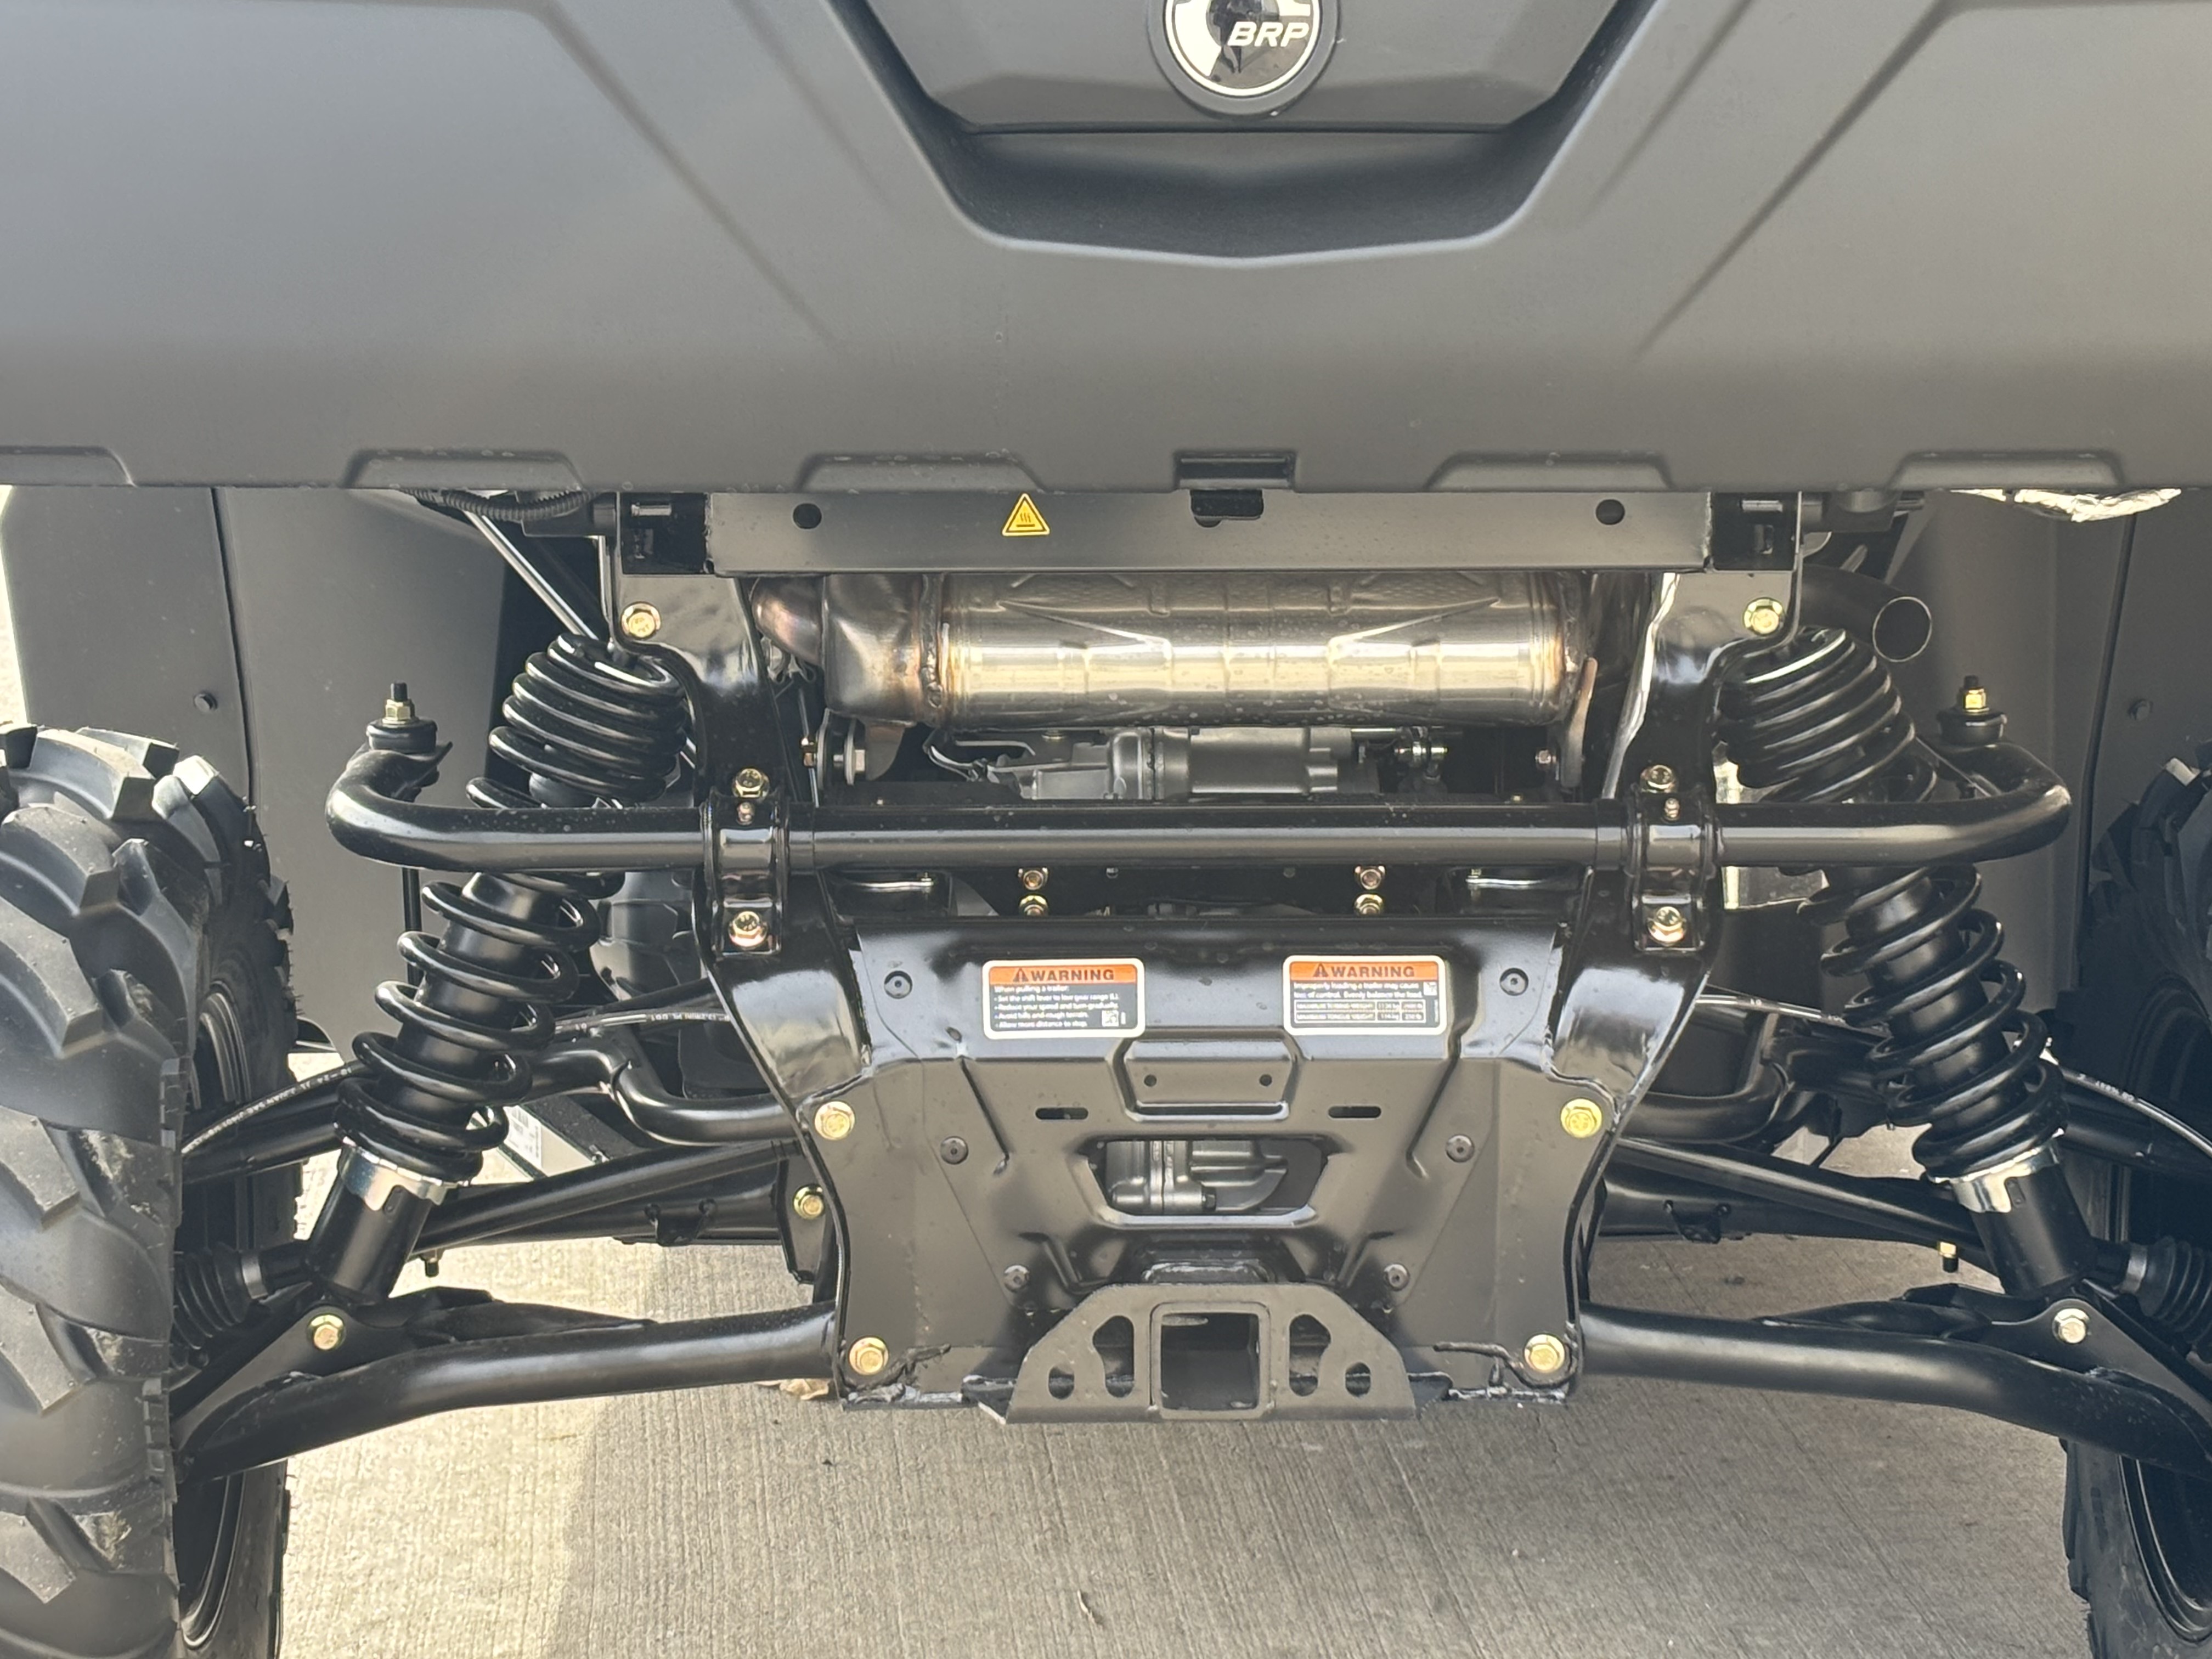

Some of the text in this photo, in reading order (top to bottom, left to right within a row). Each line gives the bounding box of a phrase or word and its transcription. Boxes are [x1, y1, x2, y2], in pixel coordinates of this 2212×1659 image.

[1227, 21, 1309, 47] BRP
[1031, 969, 1114, 981] WARNING
[1331, 966, 1415, 977] WARNING
